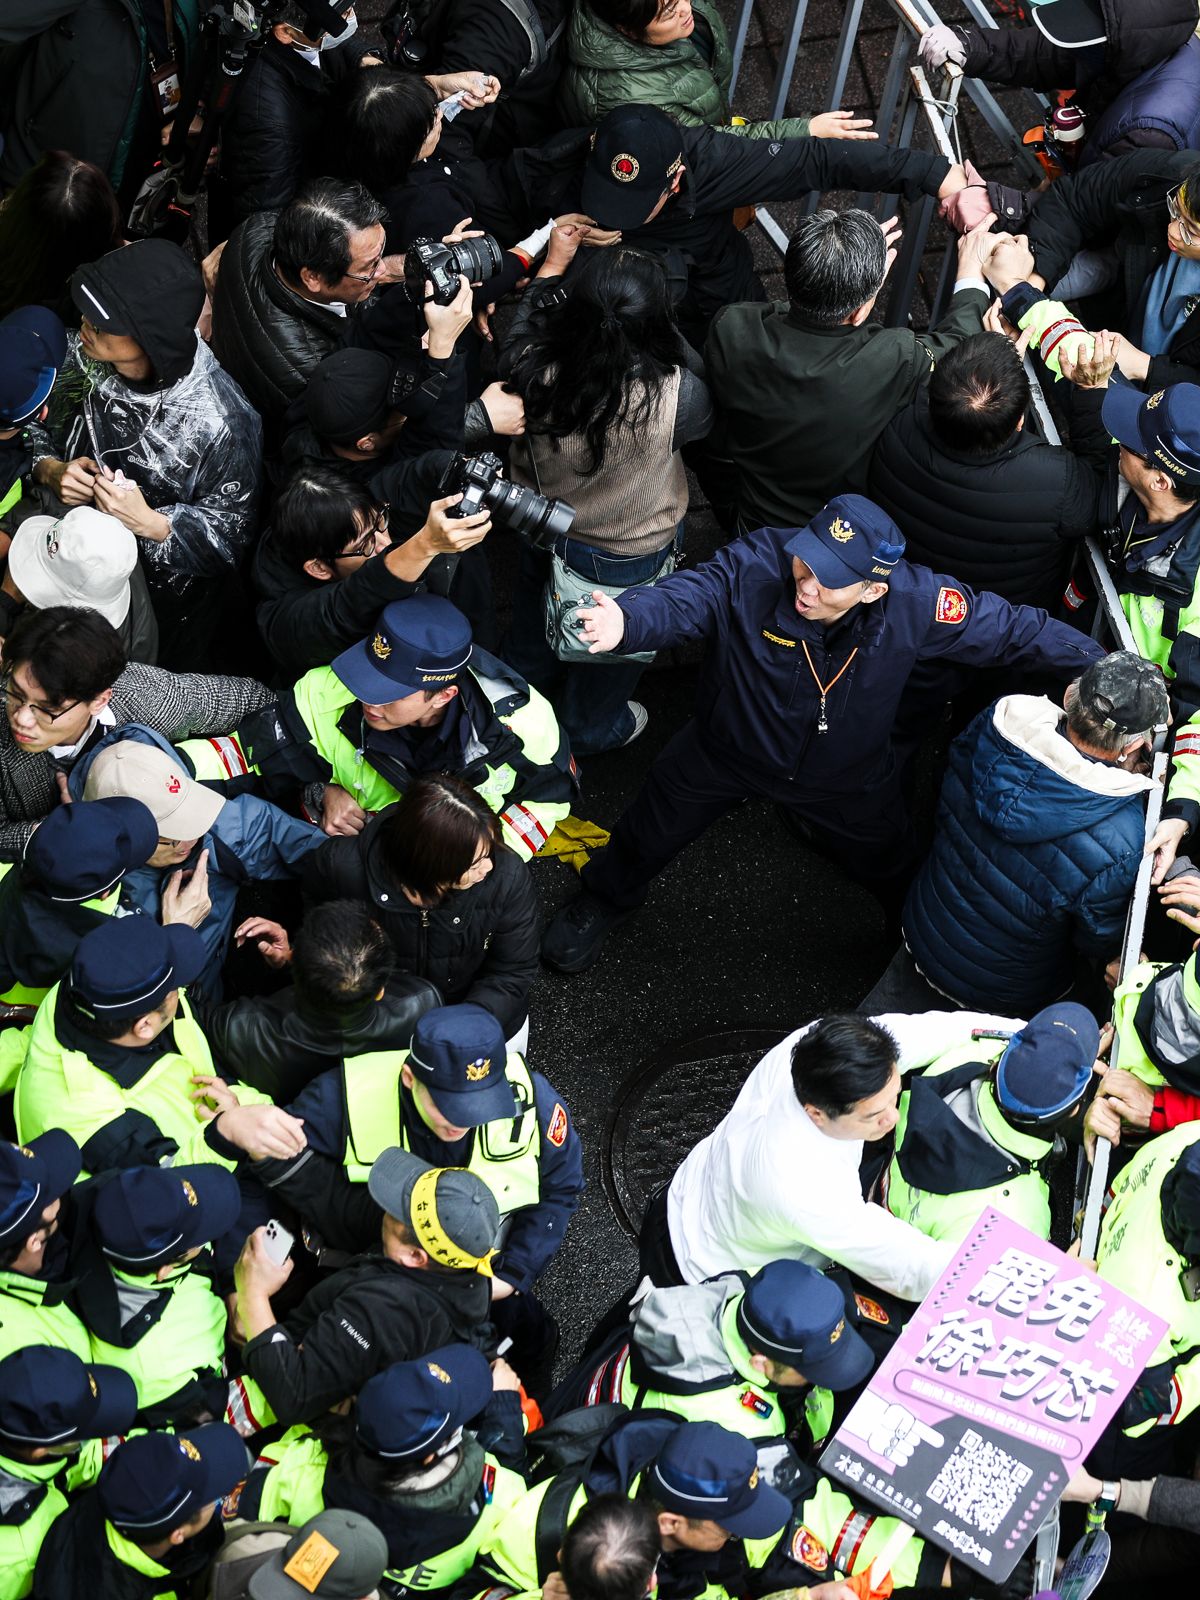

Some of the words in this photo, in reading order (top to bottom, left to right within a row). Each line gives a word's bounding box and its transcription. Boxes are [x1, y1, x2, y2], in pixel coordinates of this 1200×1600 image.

[967, 1247, 1107, 1343] 罷免
[914, 1309, 1120, 1423] 徐巧芯
